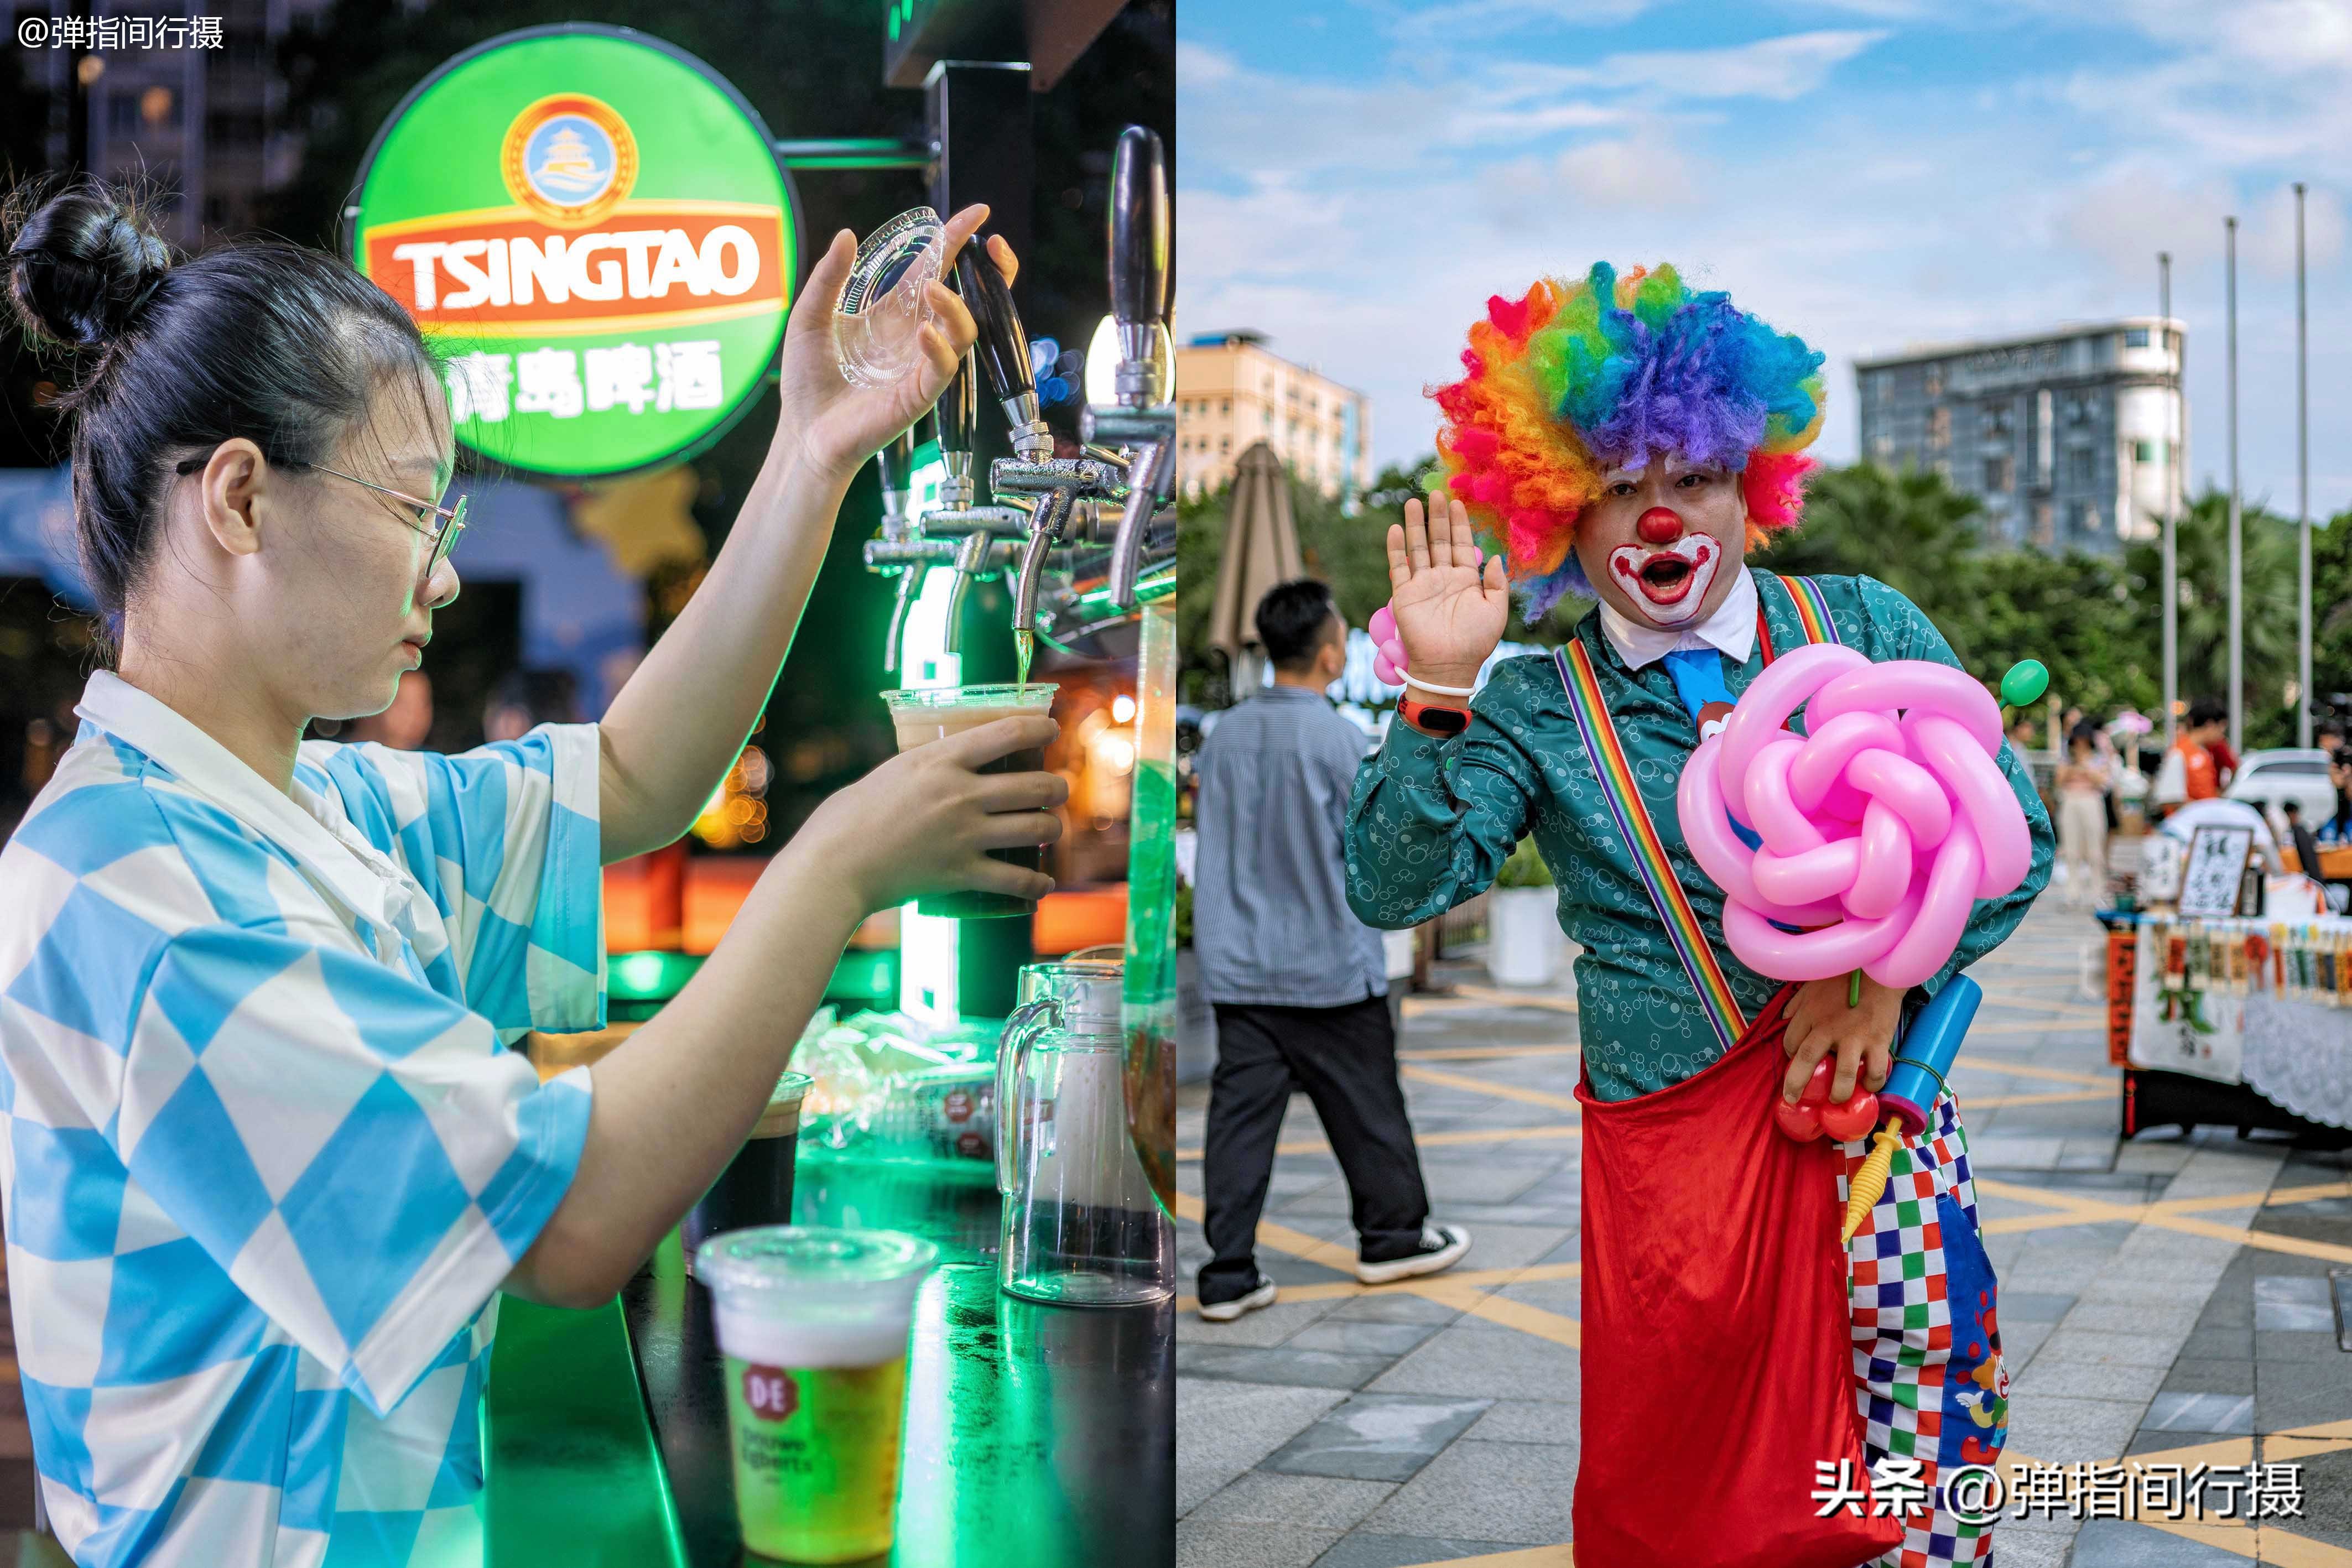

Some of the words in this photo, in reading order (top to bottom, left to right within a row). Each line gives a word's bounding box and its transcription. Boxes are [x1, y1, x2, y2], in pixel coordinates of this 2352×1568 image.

[394, 225, 760, 310] TSINGTAO
[447, 341, 722, 423] 青岛啤酒
